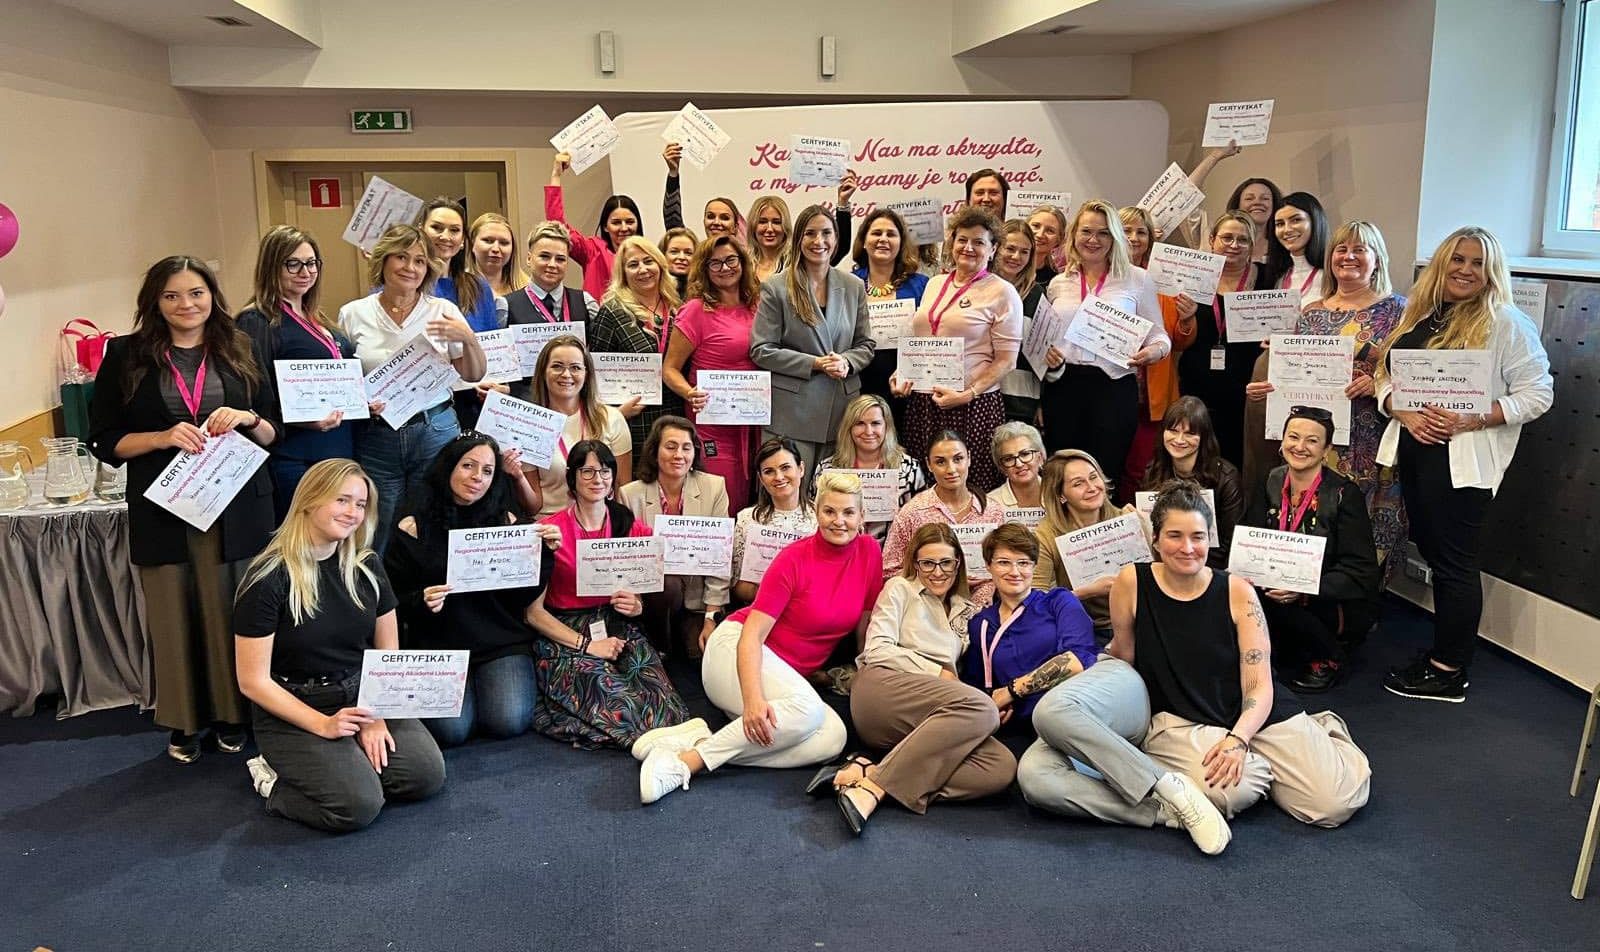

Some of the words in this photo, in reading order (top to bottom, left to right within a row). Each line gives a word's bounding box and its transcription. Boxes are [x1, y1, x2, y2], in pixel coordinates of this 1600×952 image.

[1219, 103, 1263, 112] CERTYFIKAT
[801, 137, 841, 148] CERTYFIKAT
[855, 138, 903, 162] Nas
[907, 143, 941, 157] ma
[945, 136, 1042, 160] skrzydła,
[750, 178, 766, 190] a
[770, 177, 801, 193] my
[918, 168, 943, 190] je
[1143, 172, 1172, 206] CERTYFIKAT
[351, 188, 375, 231] CERTYFIKAT
[1164, 247, 1214, 262] CERTYFIKAT
[1236, 292, 1288, 301] CERTYFIKAT
[1095, 301, 1141, 327] CERTYFIKAT
[522, 325, 572, 334] CERTYFIKAT
[1284, 338, 1340, 346] CERTYFIKAT
[289, 362, 347, 371] CERTYFIKAT
[369, 344, 416, 384] CERTYFIKAT
[710, 373, 758, 382] CERTYFIKAT
[500, 398, 554, 421] CERTYFIKAT
[668, 519, 722, 528] CERTYFIKAT
[464, 529, 527, 541] CERTYFIKAT
[1069, 519, 1124, 544] CERTYFIKAT
[1248, 530, 1310, 545] CERTYFIKAT
[591, 540, 650, 550] CERTYFIKAT
[382, 655, 452, 663] CERTYFIKAT
